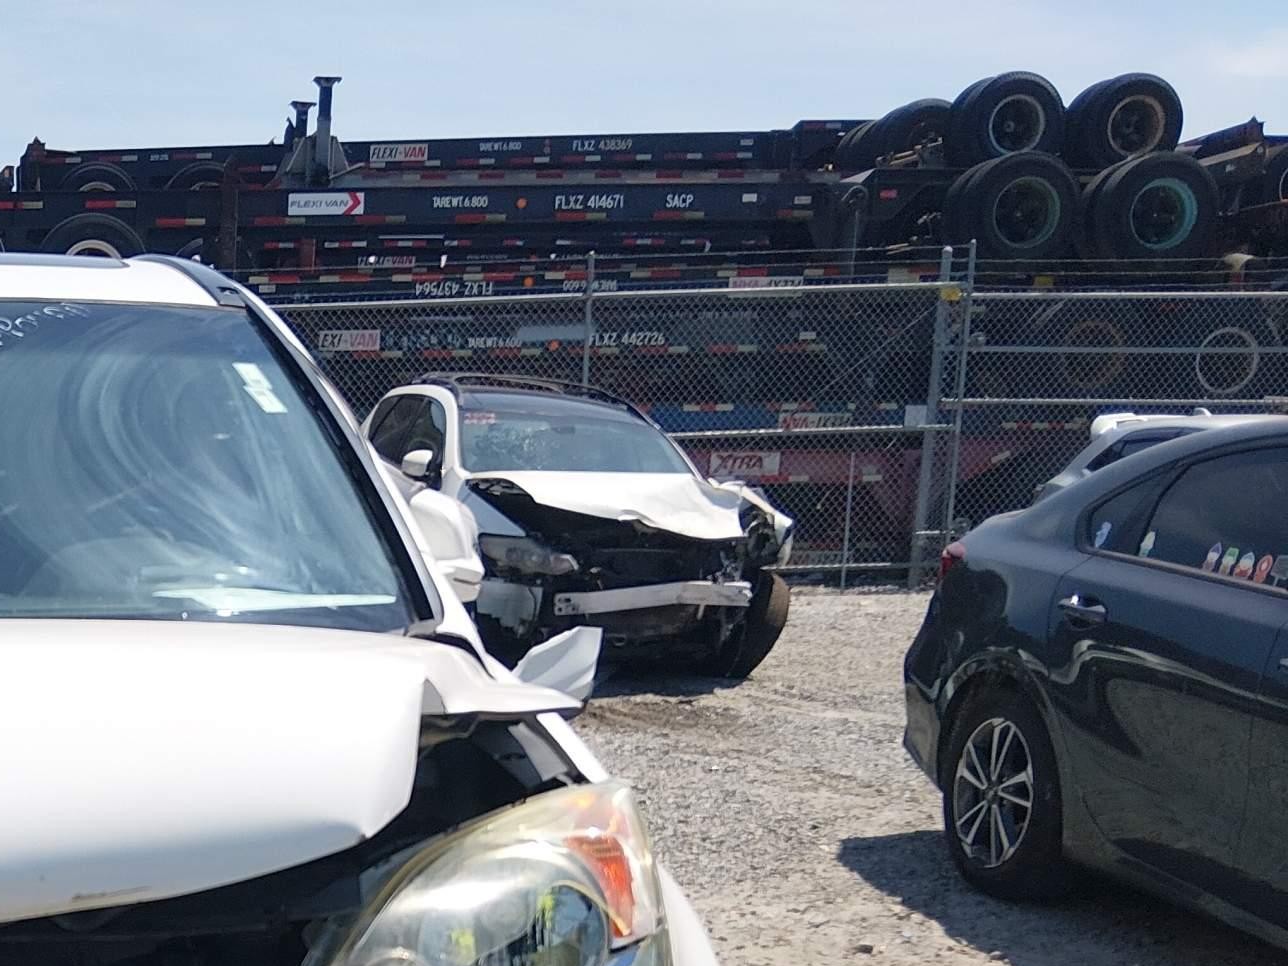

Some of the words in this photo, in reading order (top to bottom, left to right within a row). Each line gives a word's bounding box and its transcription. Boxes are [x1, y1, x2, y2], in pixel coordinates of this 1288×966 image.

[371, 146, 426, 159] FLEXI-VAN
[572, 140, 596, 151] FLXZ
[289, 200, 323, 209] FLEXI
[325, 200, 350, 208] VAN
[554, 194, 585, 210] FLXZ
[587, 194, 625, 209] 414671
[665, 193, 694, 208] SACP
[464, 280, 494, 296] FLXZ
